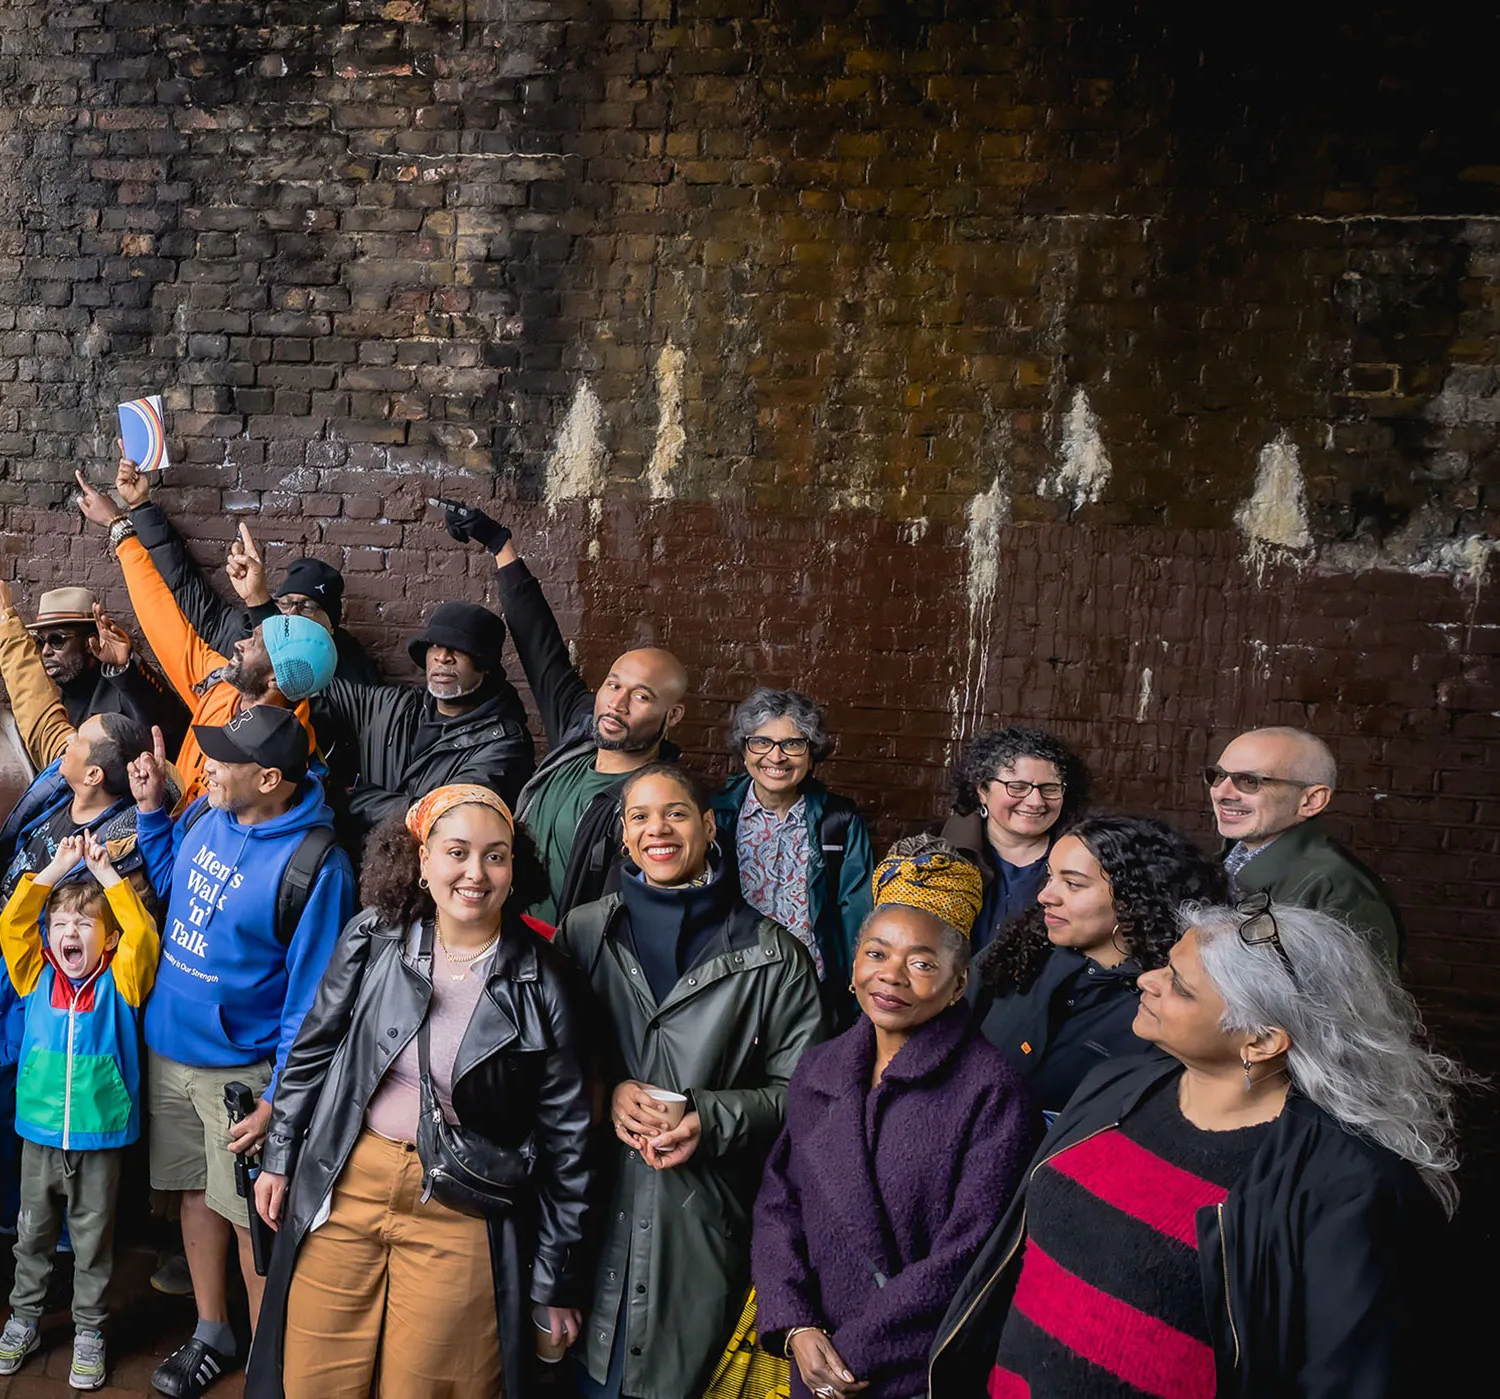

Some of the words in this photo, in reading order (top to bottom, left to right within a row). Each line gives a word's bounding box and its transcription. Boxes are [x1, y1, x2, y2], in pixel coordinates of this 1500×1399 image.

[192, 844, 245, 889] Men's
[186, 868, 229, 912] Walk
[170, 918, 210, 959] Talk
[180, 962, 192, 974] Our
[190, 968, 219, 983] Strength
